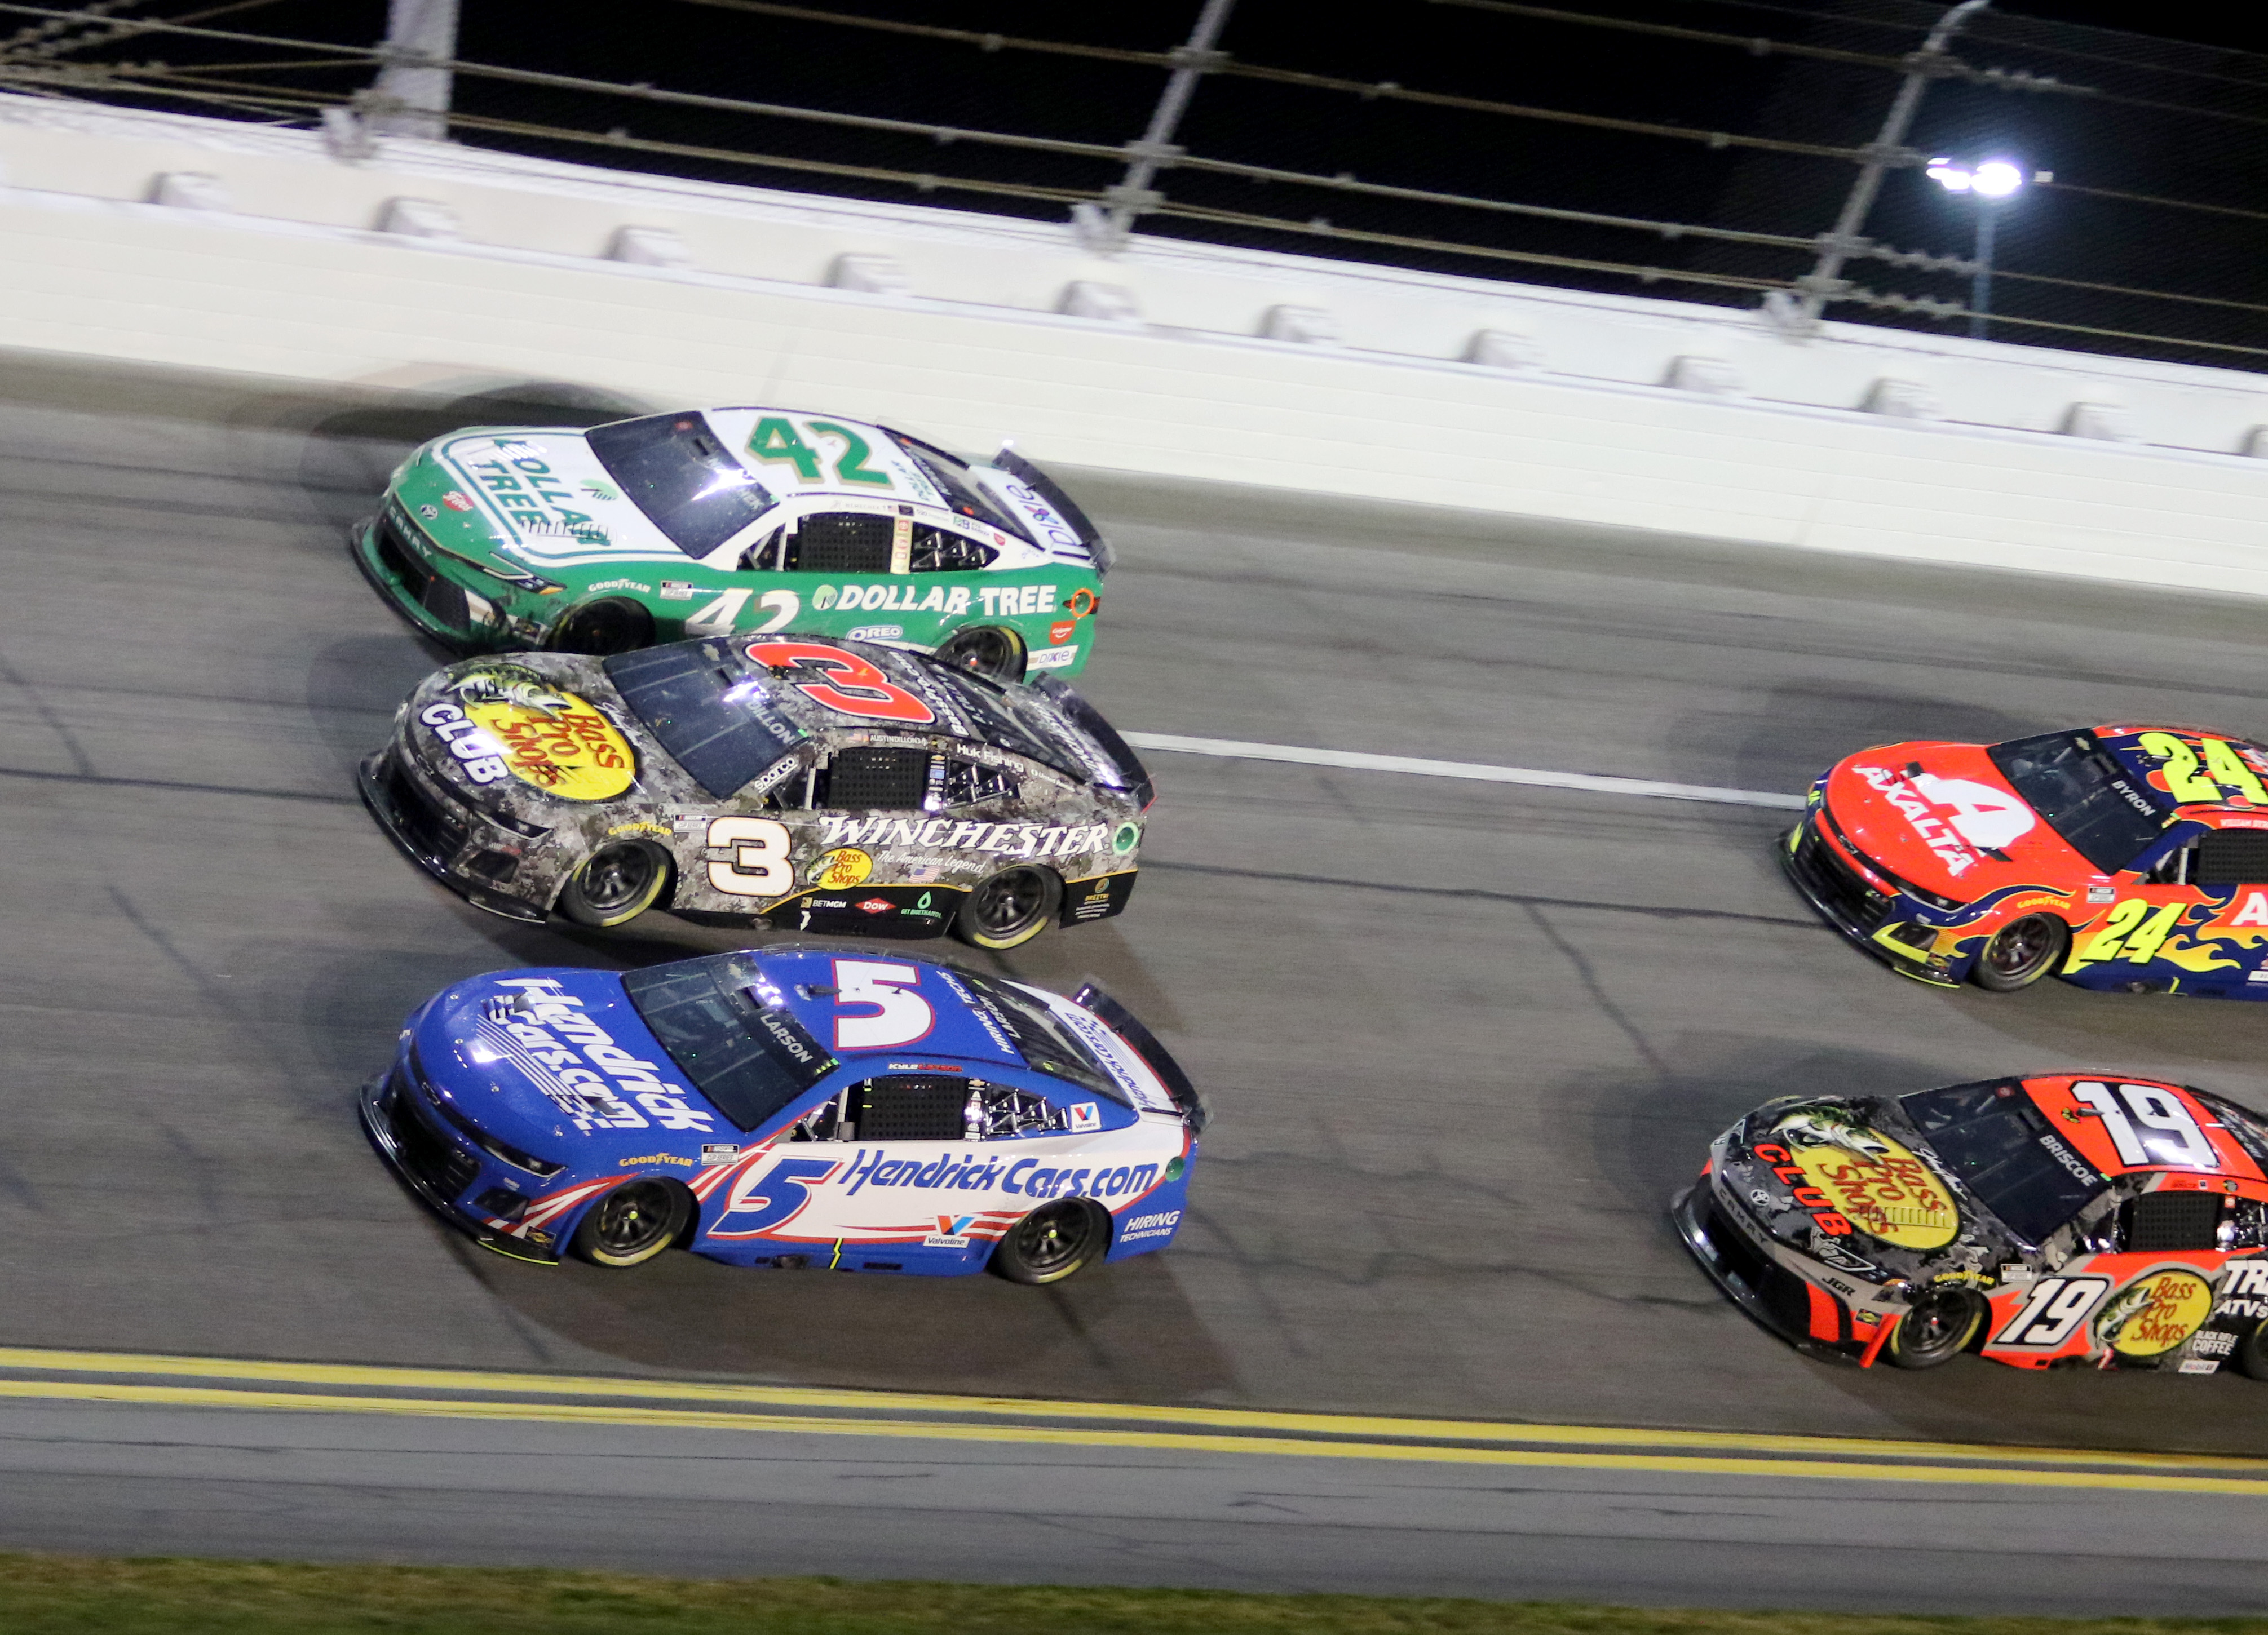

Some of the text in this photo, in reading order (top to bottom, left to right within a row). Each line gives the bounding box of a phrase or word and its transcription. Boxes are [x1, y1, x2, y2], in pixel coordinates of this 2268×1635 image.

[745, 416, 896, 490] 42
[470, 460, 551, 526] TREE
[588, 579, 651, 593] GOODYEAR
[835, 584, 1057, 616] DOLLAR TREE
[684, 588, 801, 635] 42
[849, 627, 901, 641] OREO
[744, 641, 936, 724] 3
[526, 716, 581, 756] Pro
[560, 712, 625, 768] Bass
[746, 701, 796, 744] DILLON
[419, 702, 509, 785] CLUB
[957, 743, 1024, 773] Huk Fishing
[754, 757, 795, 791] sparco
[2138, 732, 2268, 804] 24
[2111, 778, 2156, 817] BYRON
[608, 821, 672, 836] GOODYEAR
[819, 816, 1108, 857] WINCHESTER
[1851, 766, 1975, 876] AXALTA
[707, 816, 794, 896] 3
[833, 862, 852, 874] Pro
[836, 850, 862, 863] Bass
[877, 850, 987, 874] The American Legend
[828, 873, 861, 885] Shops
[812, 900, 847, 909] BETMGM
[2079, 898, 2187, 964] 24
[833, 959, 935, 1051] 5
[936, 971, 975, 1004] TECHS
[972, 1007, 1015, 1054] HIRING
[976, 994, 1021, 1039] LARSON
[493, 978, 714, 1133] Hendrick
[760, 1013, 814, 1063] LARSON
[2071, 1080, 2220, 1167] 19
[619, 1153, 693, 1167] GOODYEAR
[1850, 1159, 1905, 1200] Pro
[2039, 1134, 2098, 1186] BRISCOE
[706, 1154, 843, 1238] 5
[1754, 1144, 1853, 1235] CLUB
[1881, 1156, 1948, 1210] Bass
[928, 1237, 965, 1246] Valvoline
[1120, 1227, 1173, 1243] TECHNICIANS
[1124, 1210, 1181, 1233] HIRING
[1822, 1277, 1856, 1296] JGR
[1934, 1270, 1995, 1285] GOODYEAR
[2152, 1277, 2196, 1299] Bass
[1999, 1278, 2108, 1345] 19
[2142, 1299, 2177, 1322] Pro
[2130, 1322, 2188, 1347] Shops
[2192, 1339, 2234, 1355] COFFEE
[2196, 1330, 2217, 1339] BLACK
